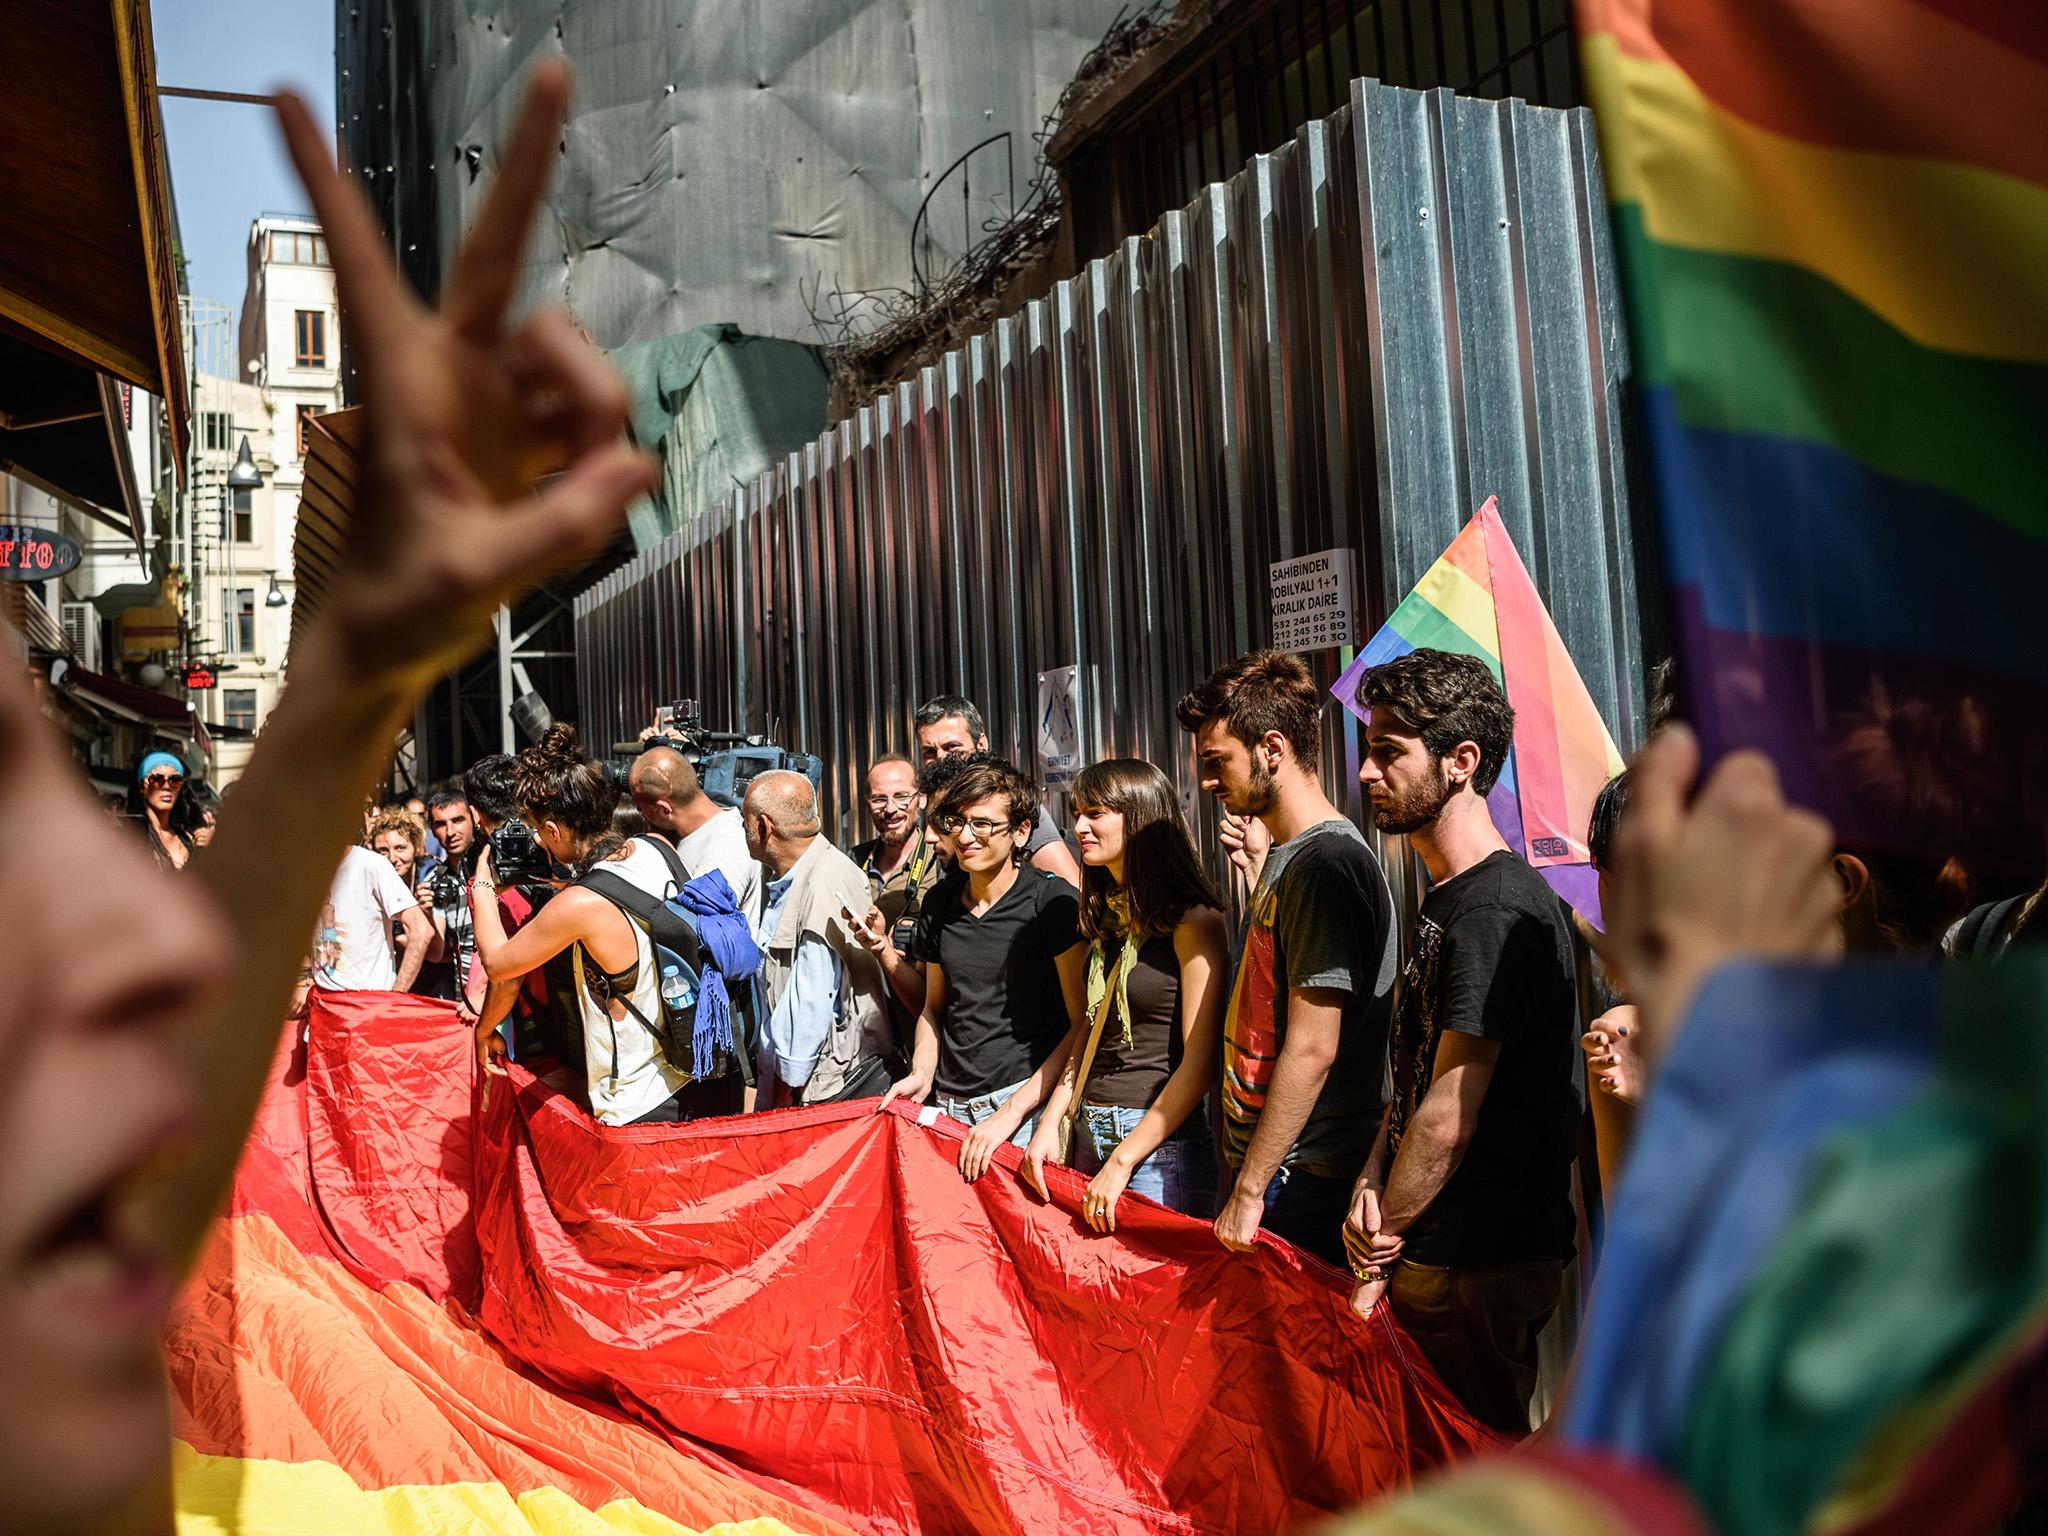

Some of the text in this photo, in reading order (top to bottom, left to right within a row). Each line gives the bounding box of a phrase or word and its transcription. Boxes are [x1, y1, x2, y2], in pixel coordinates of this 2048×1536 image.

[1272, 558, 1329, 582] SAHİBİNDEN
[1317, 574, 1338, 590] 1+1
[1272, 592, 1338, 617] KİRALIK DAİRE
[1274, 610, 1346, 630] 532 244 65 29
[1274, 621, 1346, 640] 212 245 36 89
[1275, 632, 1347, 650] 212 245 76 30
